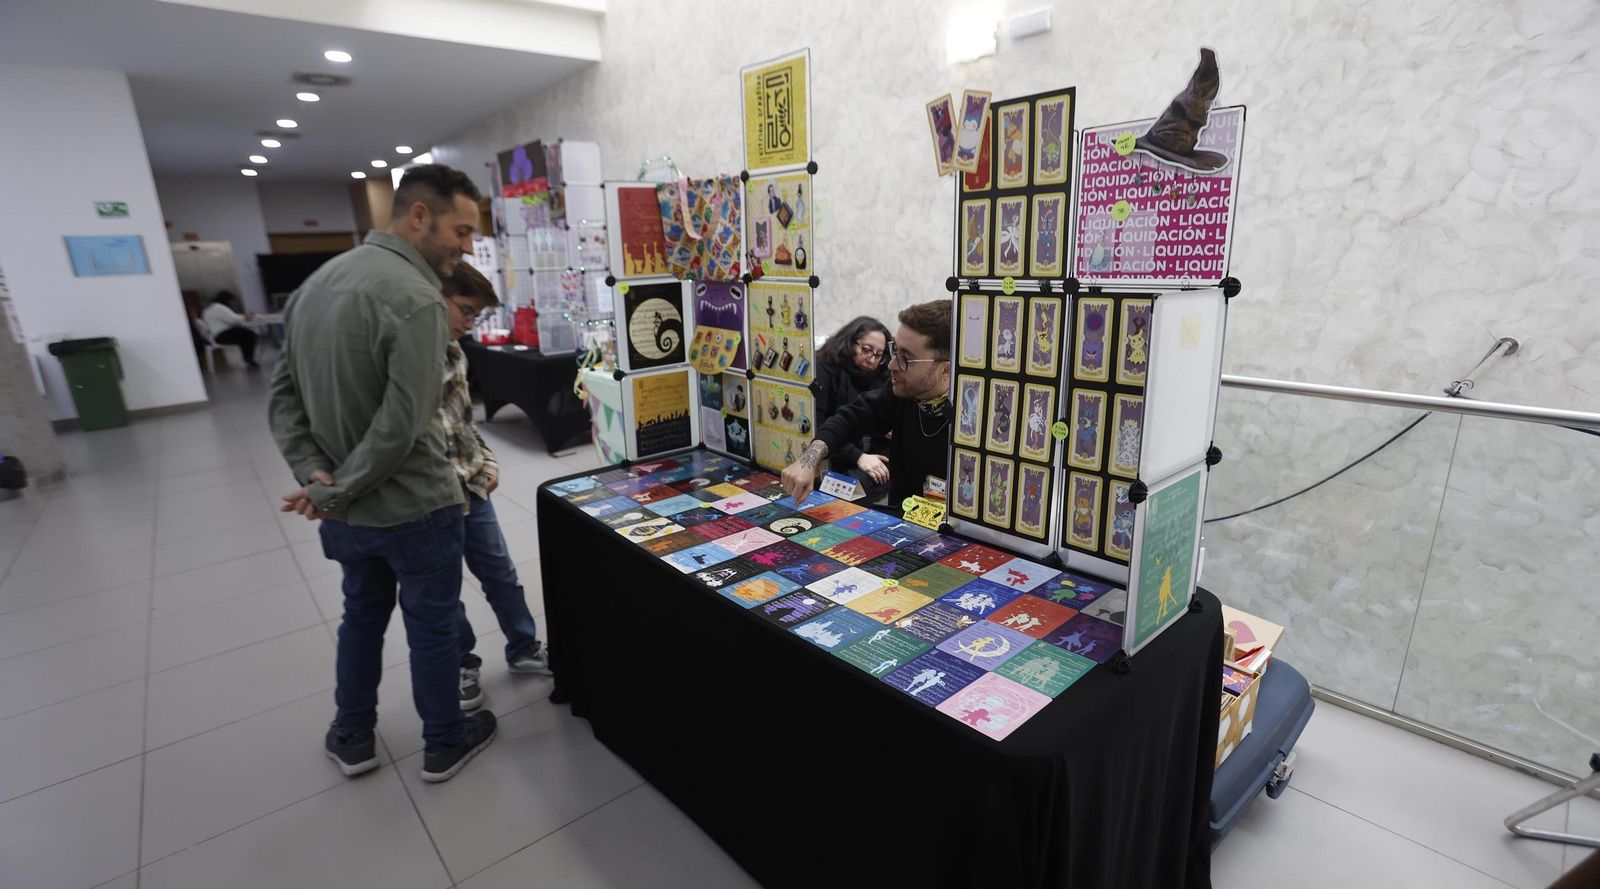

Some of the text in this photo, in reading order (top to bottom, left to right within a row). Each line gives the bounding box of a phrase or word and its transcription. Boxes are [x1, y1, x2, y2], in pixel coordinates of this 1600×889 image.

[1115, 179, 1211, 201] LIQUIDACIÓN
[1081, 213, 1170, 230] LIQUIDACIÓN
[1112, 226, 1206, 243] LIQUIDACIÓN
[1079, 257, 1167, 272] LIUIDACIÓN
